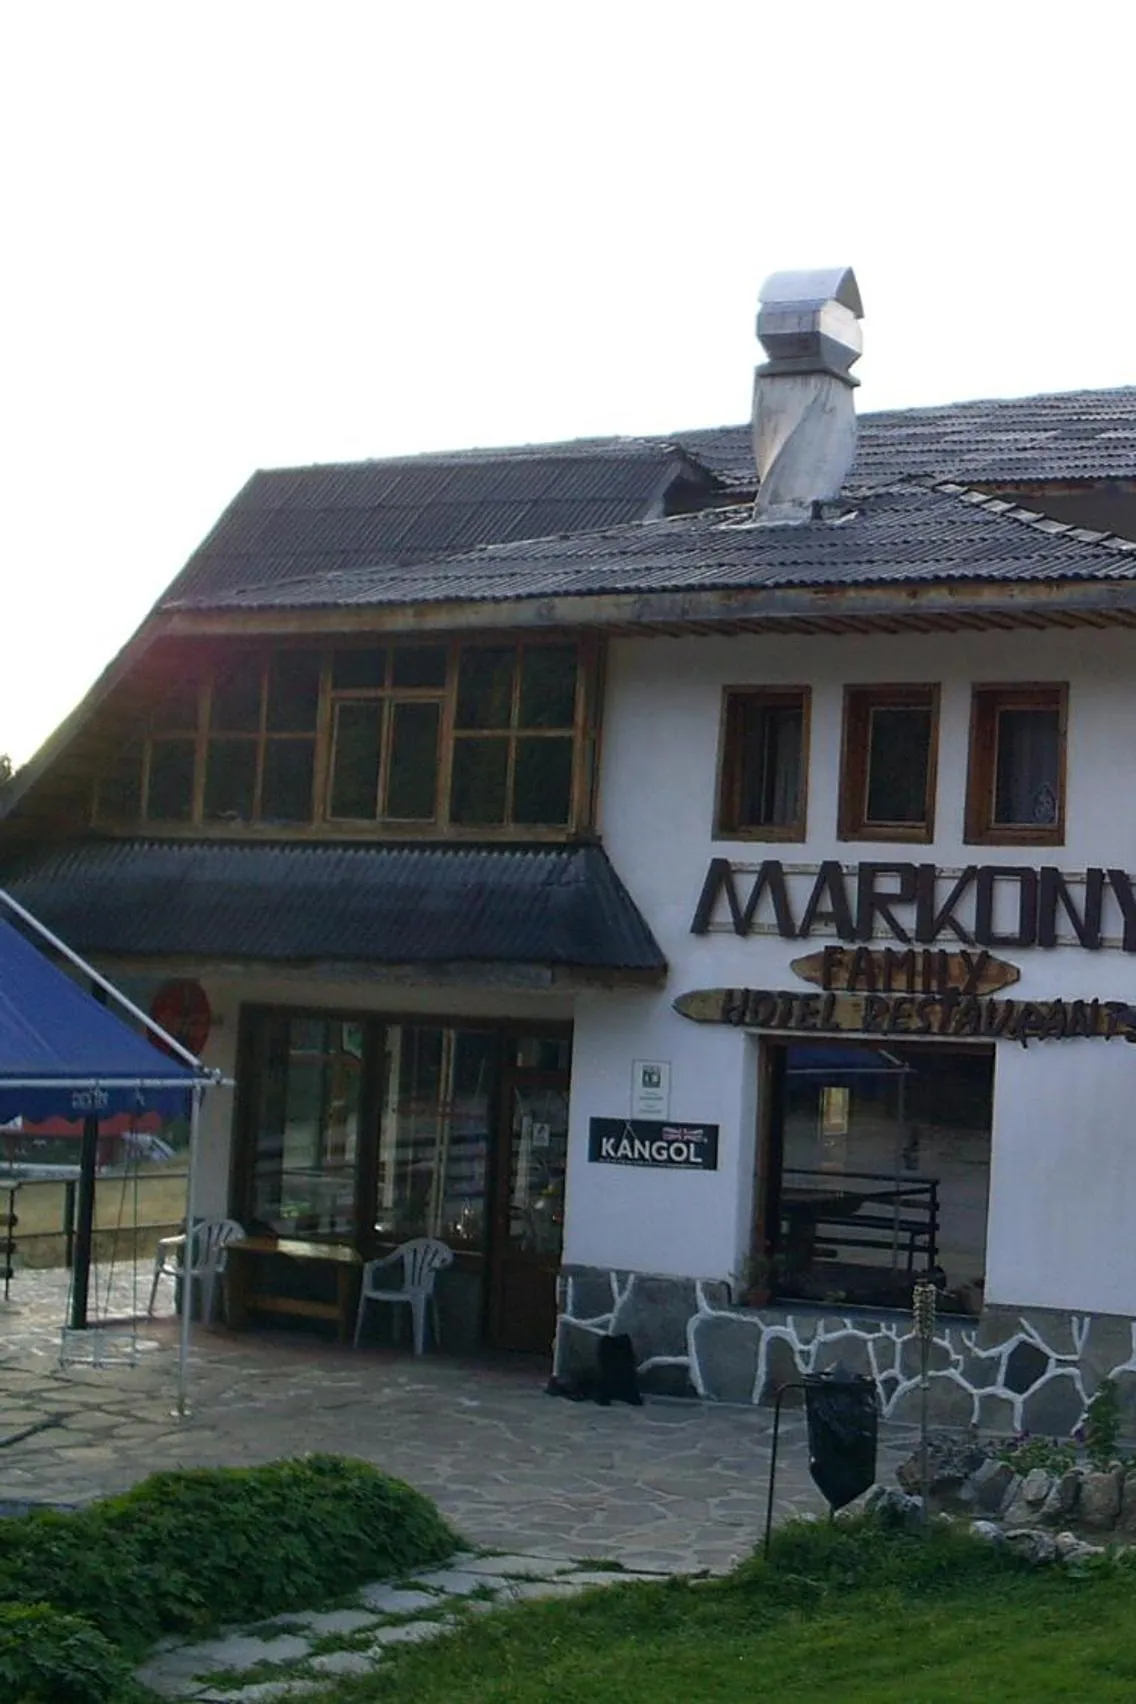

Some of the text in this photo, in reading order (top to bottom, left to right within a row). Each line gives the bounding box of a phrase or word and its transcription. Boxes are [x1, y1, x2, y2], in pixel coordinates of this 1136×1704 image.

[822, 946, 989, 994] FAMILY
[720, 988, 1129, 1046] HOTEL RESTAURANT
[601, 1137, 703, 1163] KANGOL
